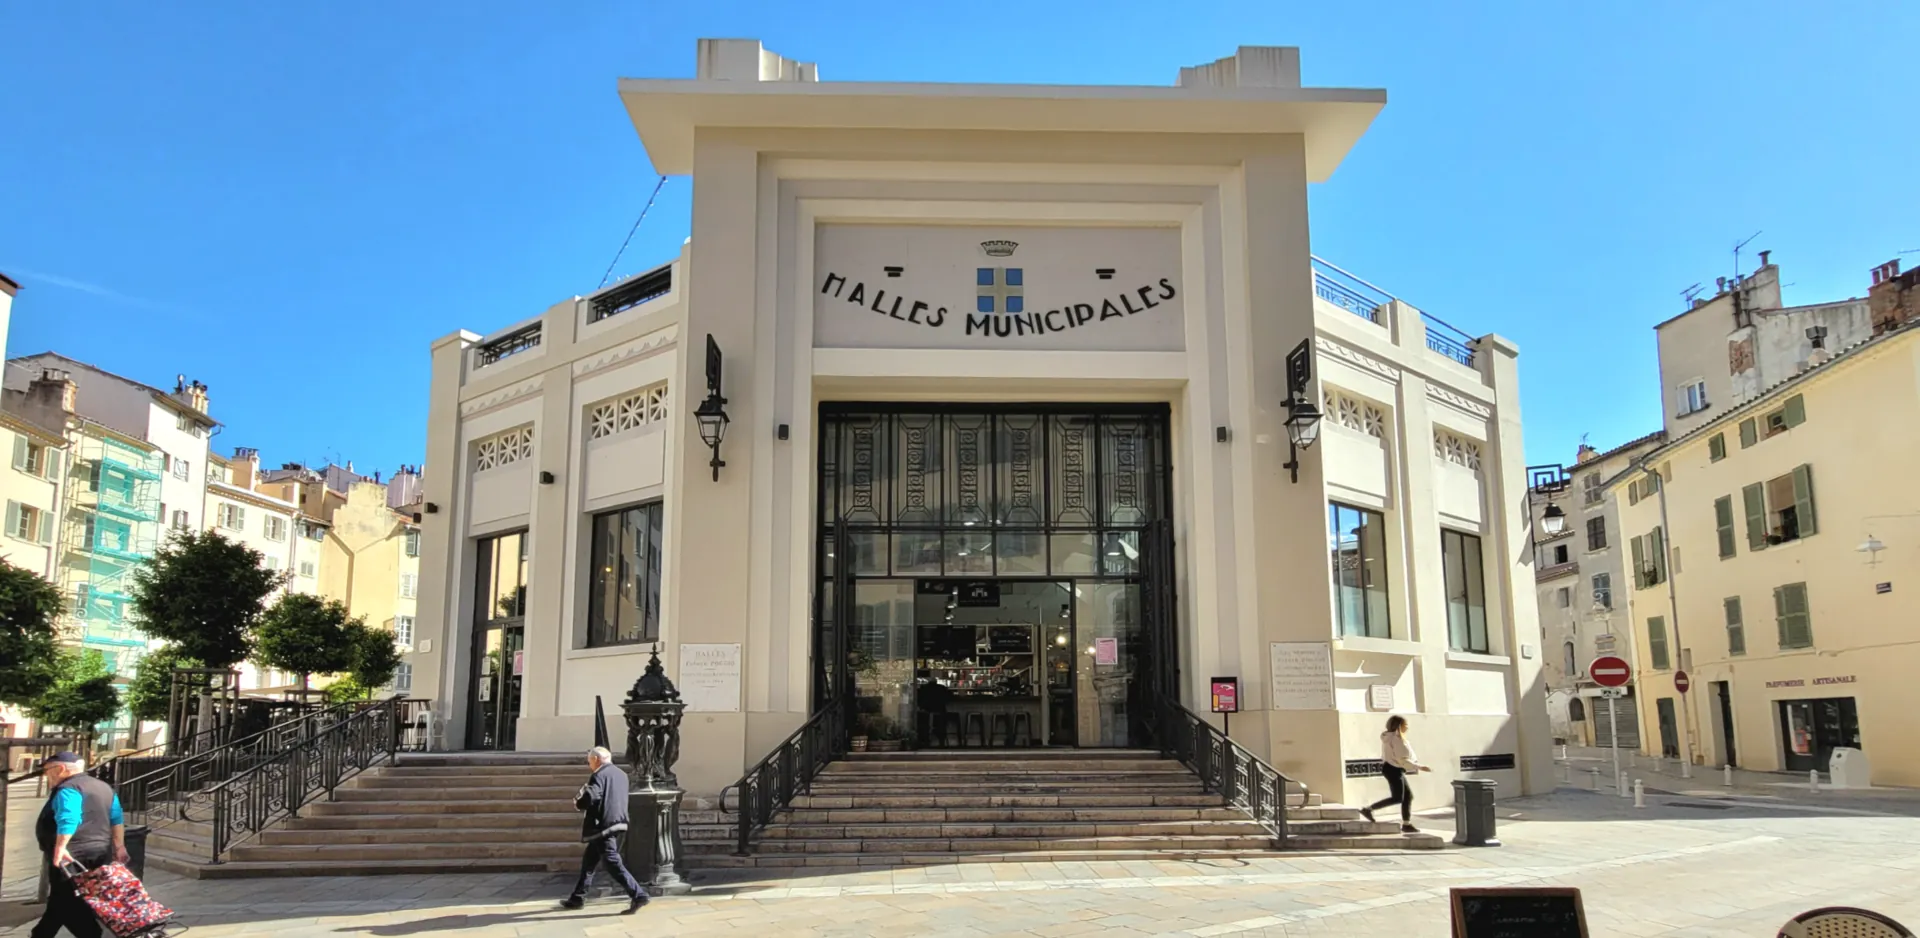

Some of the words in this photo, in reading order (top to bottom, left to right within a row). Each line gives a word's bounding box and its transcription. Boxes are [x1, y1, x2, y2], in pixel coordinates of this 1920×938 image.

[821, 272, 947, 327] HALLES
[965, 278, 1176, 337] MUNICIPALES
[1812, 675, 1857, 686] ARTISANALE
